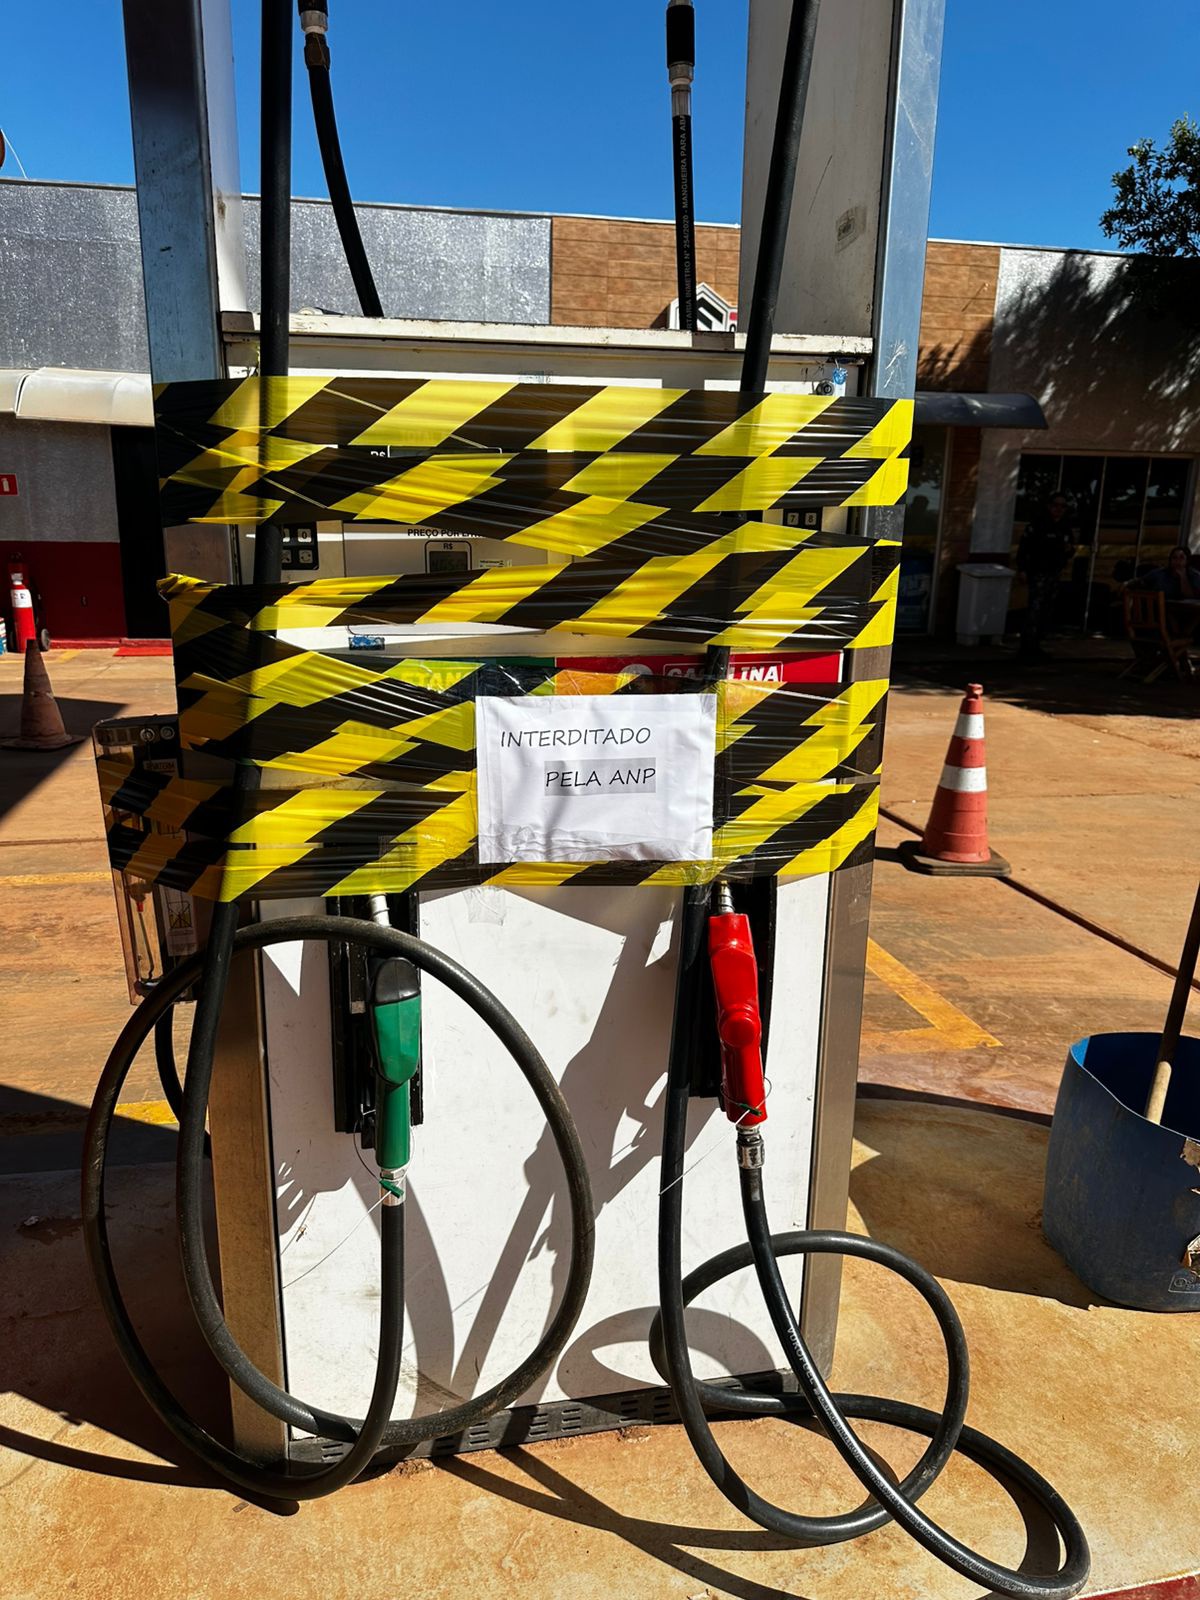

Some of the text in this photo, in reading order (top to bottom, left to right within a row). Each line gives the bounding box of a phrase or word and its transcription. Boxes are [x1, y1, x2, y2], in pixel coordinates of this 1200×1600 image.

[679, 133, 687, 157] PARA
[680, 158, 689, 209] MANGUEIRA
[684, 261, 692, 297] INMETRO
[407, 528, 439, 539] PREÇO
[500, 727, 651, 748] INTERDITADO
[545, 768, 656, 787] PELA ANP
